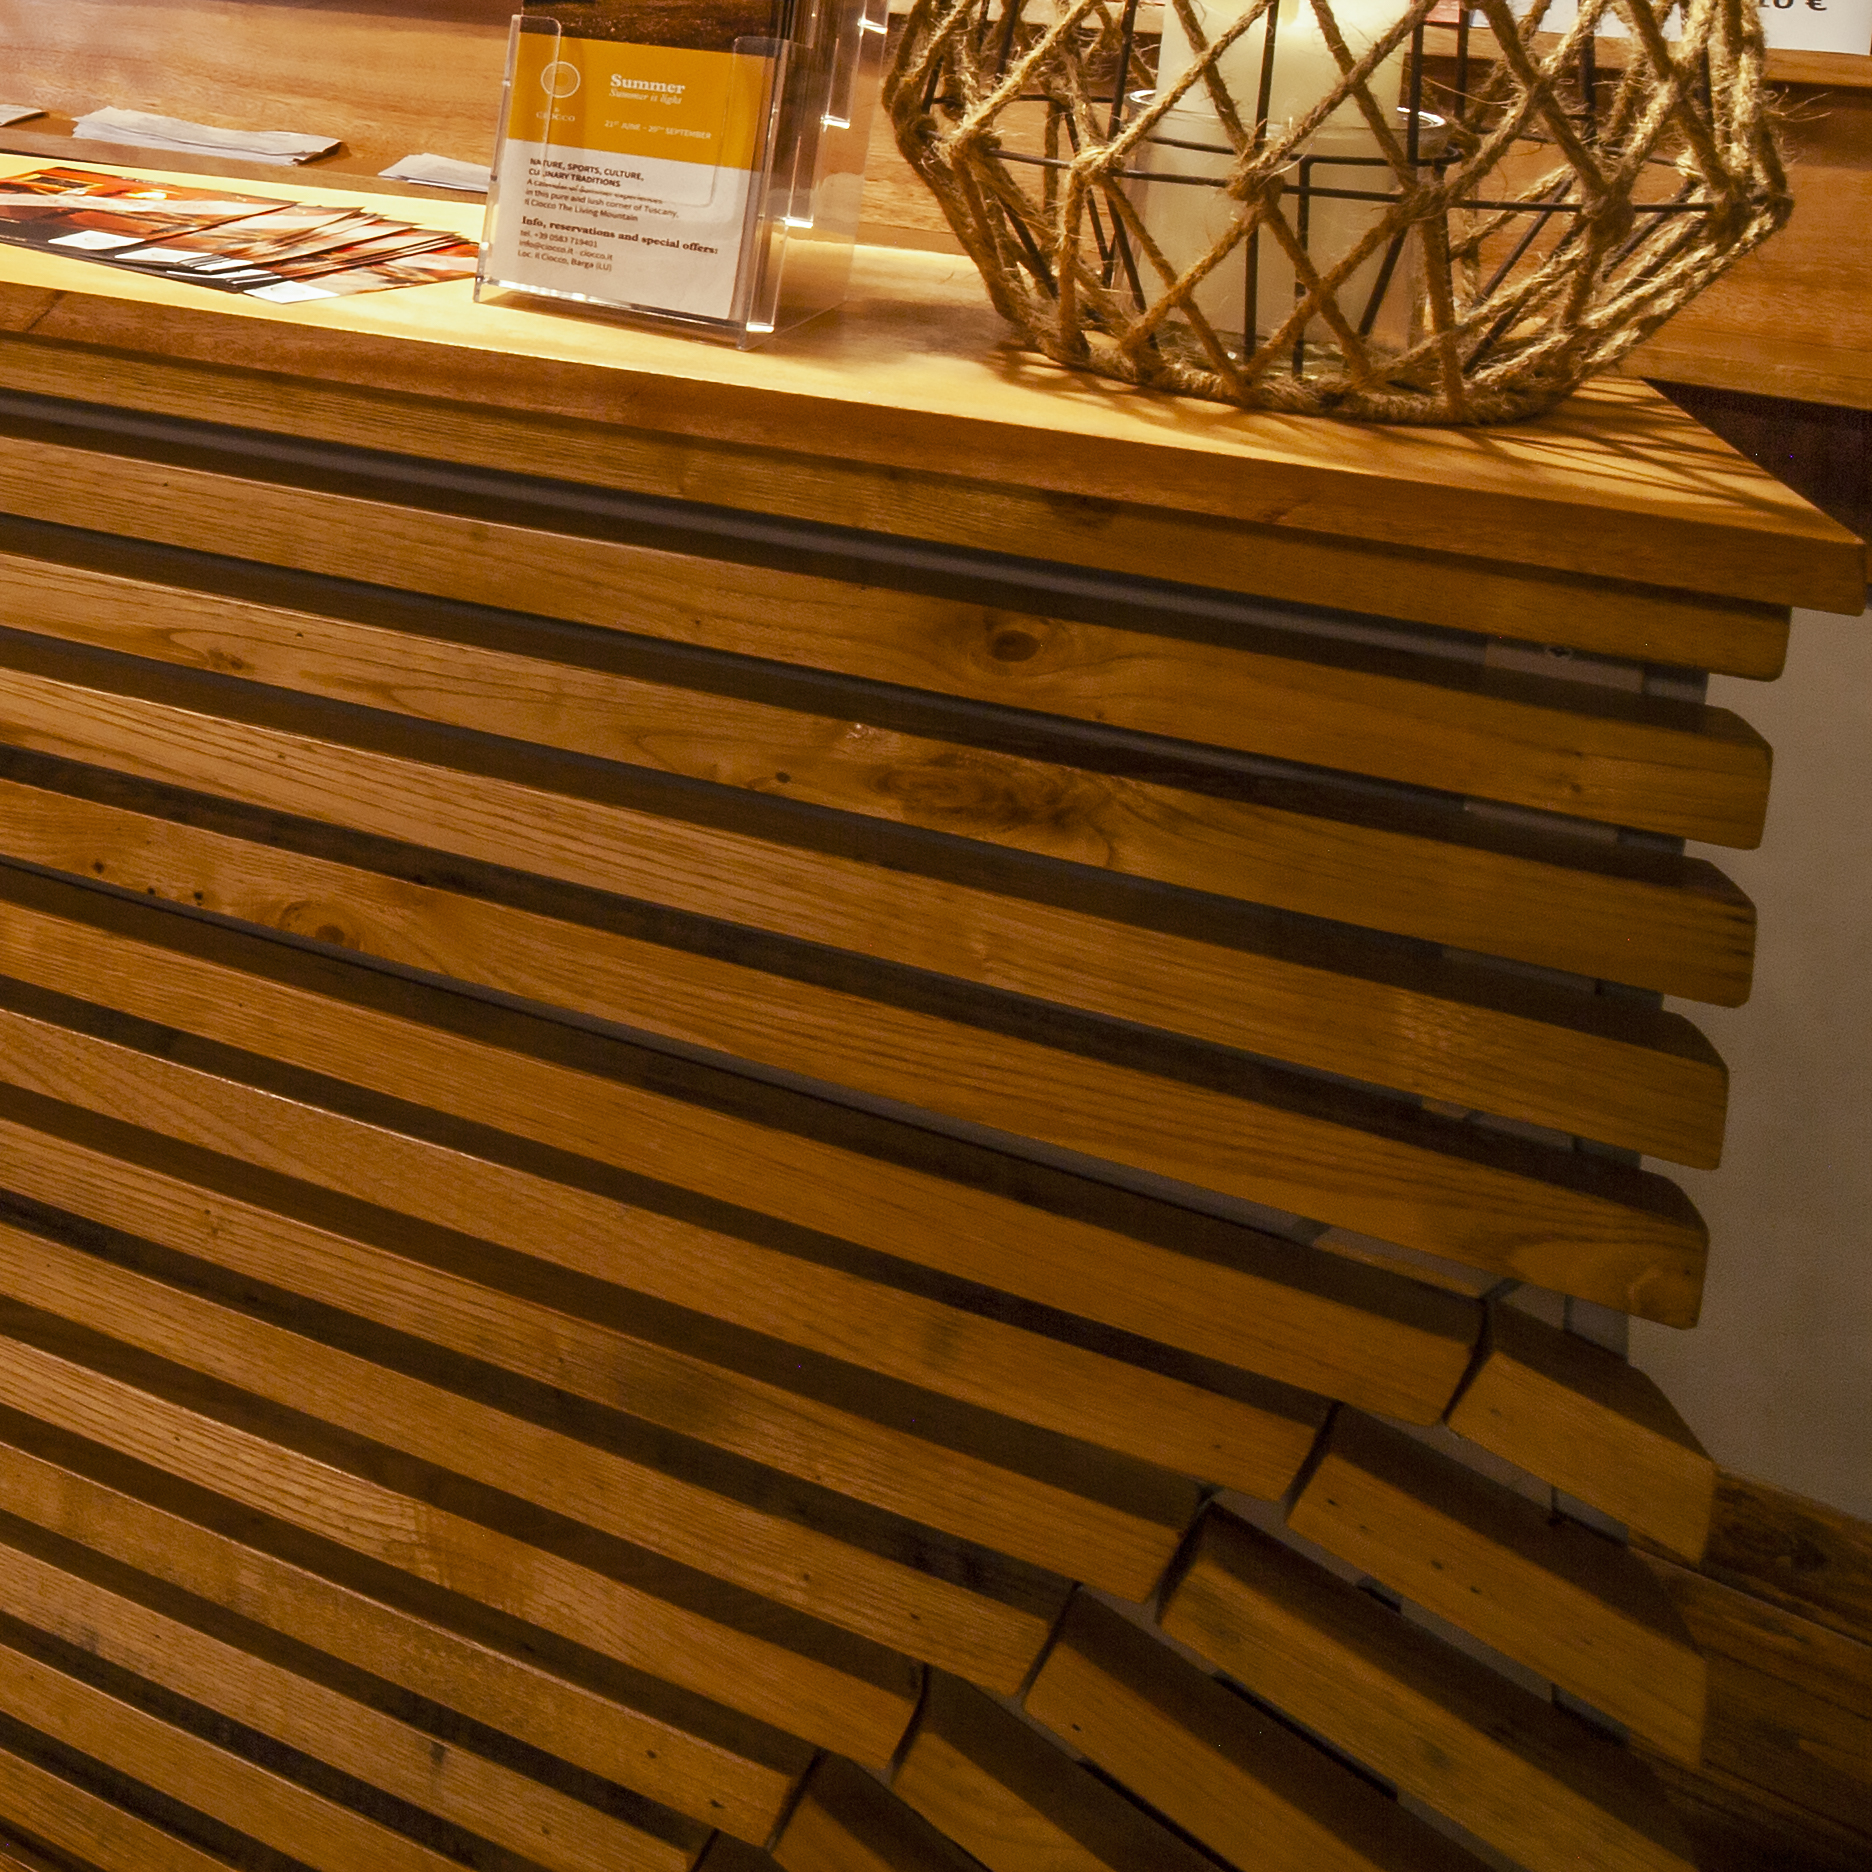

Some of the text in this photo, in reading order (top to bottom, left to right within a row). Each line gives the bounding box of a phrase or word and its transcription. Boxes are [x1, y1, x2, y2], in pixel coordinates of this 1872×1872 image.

[610, 73, 686, 94] Summer
[665, 127, 712, 139] SEPTEMBER
[567, 163, 603, 175] SPORTS,
[604, 168, 645, 181] CULTURE,
[571, 173, 621, 188] TRADITIONS
[531, 198, 557, 210] Ciocco
[558, 202, 574, 213] The
[575, 205, 599, 218] Living
[599, 209, 639, 222] Mountain
[534, 189, 550, 199] this
[550, 192, 570, 201] pure
[570, 194, 586, 204] and
[587, 196, 604, 207] lush
[606, 199, 632, 210] corner
[633, 202, 644, 211] of
[644, 205, 680, 219] Tuscany,
[522, 215, 719, 255] Info, reservations and special offers:
[519, 240, 614, 261] info@ciocco.it ciocco.it
[540, 252, 570, 266] Ciocco,
[570, 257, 595, 270] Barga
[595, 260, 613, 273] (LU)
